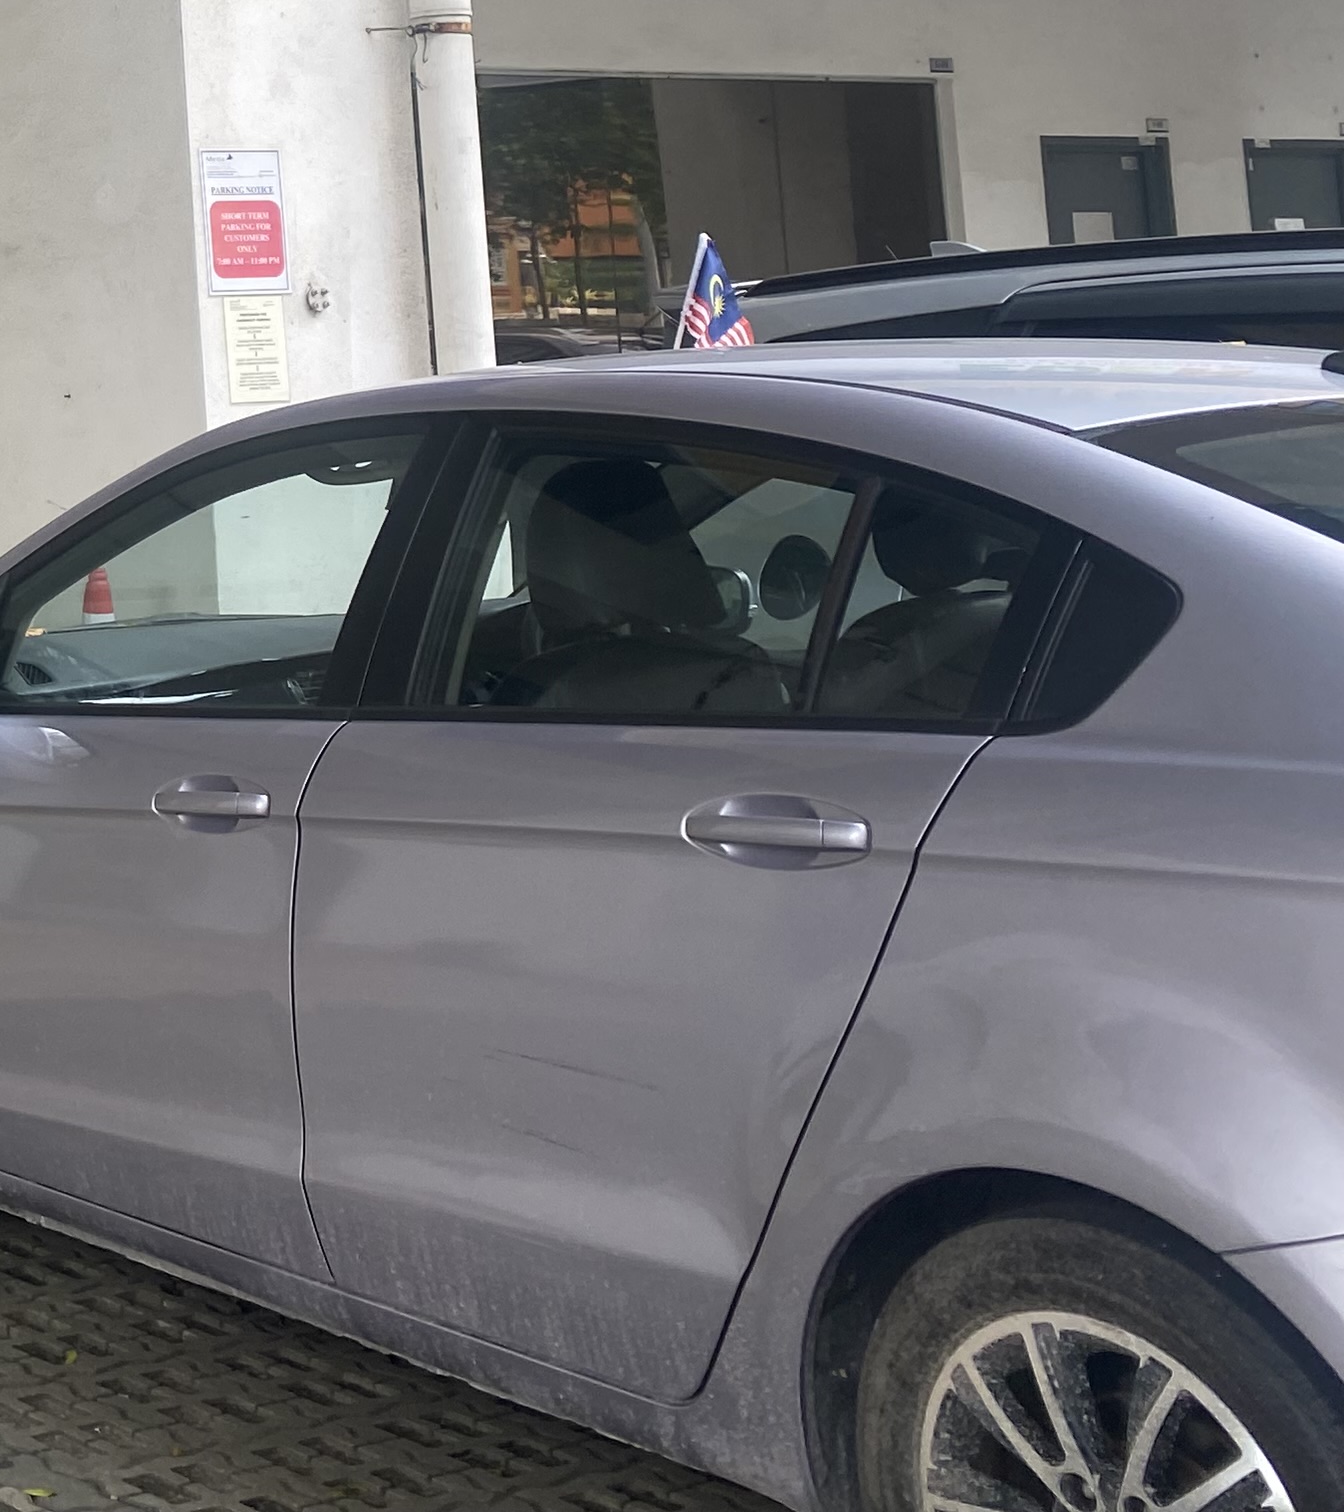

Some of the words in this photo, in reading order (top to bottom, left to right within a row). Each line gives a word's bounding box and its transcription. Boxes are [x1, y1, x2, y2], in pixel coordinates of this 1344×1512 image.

[210, 186, 244, 194] PARKING
[246, 186, 274, 194] NOTICE
[221, 211, 246, 220] SHORT
[248, 211, 269, 220] TERM
[224, 233, 270, 242] CUSTOMERS
[237, 245, 258, 253] ONLY
[232, 257, 244, 265] AM
[269, 256, 280, 264] PM
